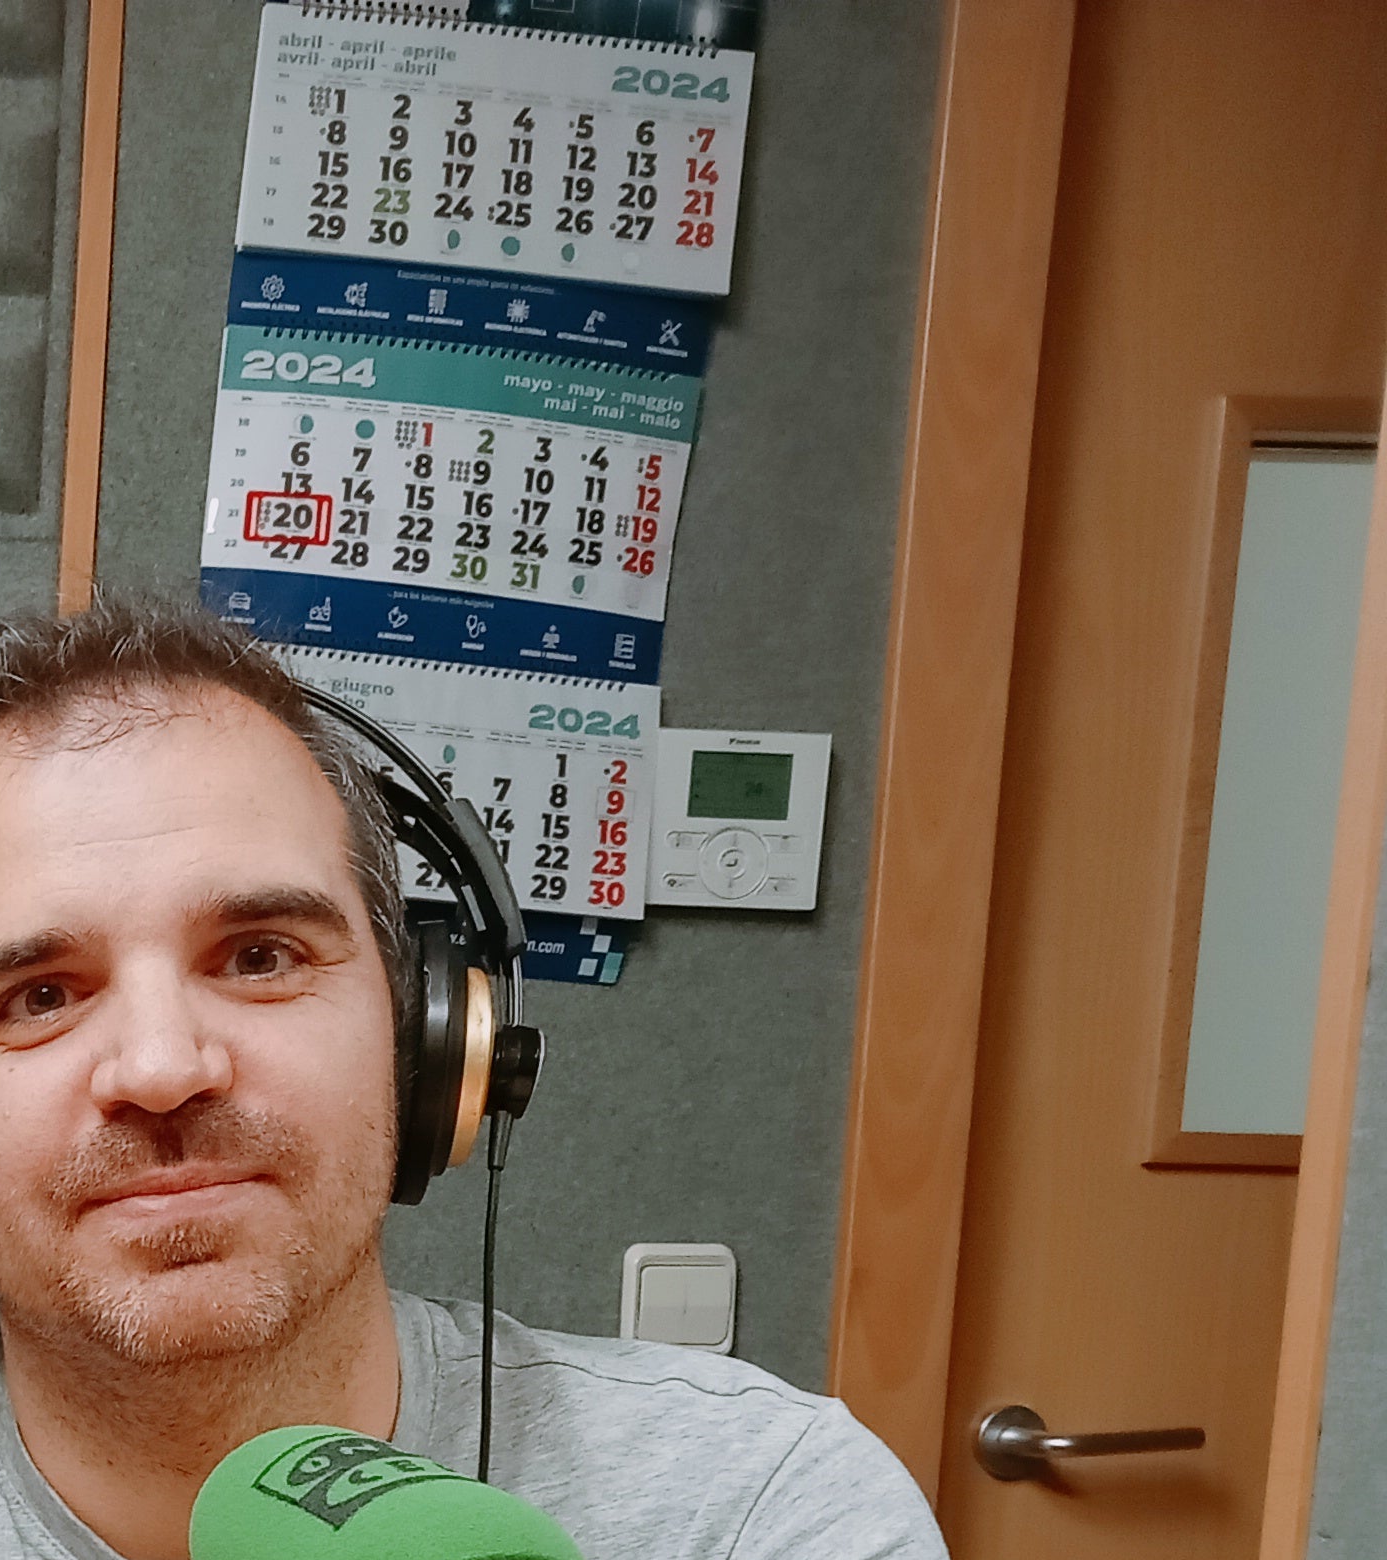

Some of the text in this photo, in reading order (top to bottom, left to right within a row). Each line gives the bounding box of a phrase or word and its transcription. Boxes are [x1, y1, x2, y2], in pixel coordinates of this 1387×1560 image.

[279, 33, 457, 61] abril april aprile
[331, 55, 375, 71] april
[393, 60, 437, 76] abril
[611, 66, 730, 102] 2024
[334, 88, 347, 114] 1
[392, 94, 412, 120] 2
[454, 99, 474, 126] 3
[512, 107, 535, 133] 4
[576, 114, 594, 139] 5
[636, 120, 656, 146] 6
[696, 128, 716, 153] 7
[326, 120, 347, 146] 8
[389, 125, 409, 151] 9
[444, 130, 477, 158] 10
[509, 137, 534, 164] 11
[567, 144, 598, 172] 12
[627, 151, 658, 179] 13
[685, 158, 719, 185] 14
[318, 151, 349, 178] 15
[379, 155, 413, 184] 16
[442, 161, 475, 189] 17
[501, 168, 534, 197] 18
[562, 175, 595, 203] 19
[617, 183, 658, 211] 20
[683, 190, 715, 217] 21
[307, 213, 346, 240] 29
[368, 218, 409, 247] 30
[310, 182, 349, 210] 22
[373, 187, 411, 215] 23
[433, 193, 475, 221] 24
[494, 200, 532, 228] 25
[555, 207, 595, 236] 26
[614, 214, 655, 241] 27
[676, 220, 715, 249] 28
[240, 349, 377, 388] 2024
[503, 373, 684, 414] mayo may maggio
[544, 396, 681, 430] mai mai maio
[421, 422, 434, 448] 1
[477, 429, 495, 455] 2
[533, 436, 553, 463] 3
[589, 446, 609, 472] 4
[644, 454, 663, 481] 5
[290, 441, 311, 467] 6
[352, 446, 373, 472] 7
[413, 453, 434, 479] 8
[472, 460, 492, 486] 9
[524, 466, 555, 496] 10
[585, 476, 608, 503] 11
[636, 484, 662, 514] 12
[281, 471, 313, 497] 13
[341, 477, 375, 505] 14
[405, 483, 435, 512] 15
[463, 490, 494, 519] 16
[520, 499, 551, 527] 17
[576, 507, 606, 536] 18
[631, 516, 658, 544] 19
[272, 502, 313, 530] 20
[338, 509, 371, 536] 21
[396, 515, 434, 543] 22
[455, 521, 492, 550] 23
[510, 529, 549, 559] 24
[568, 538, 604, 567] 25
[622, 547, 656, 576] 26
[270, 535, 311, 561] 27
[331, 539, 369, 568] 28
[392, 546, 431, 574] 29
[450, 553, 488, 581] 30
[510, 562, 542, 590] 31
[331, 677, 394, 697] giugno
[528, 704, 640, 740] 2024
[555, 754, 628, 785] 1 2
[493, 777, 512, 802] 7
[549, 784, 568, 809] 8
[606, 790, 625, 815] 9
[483, 807, 627, 846] 14 15 16
[534, 844, 570, 871] 22
[591, 850, 627, 876] 23
[529, 874, 567, 901] 29
[587, 881, 626, 907] 30
